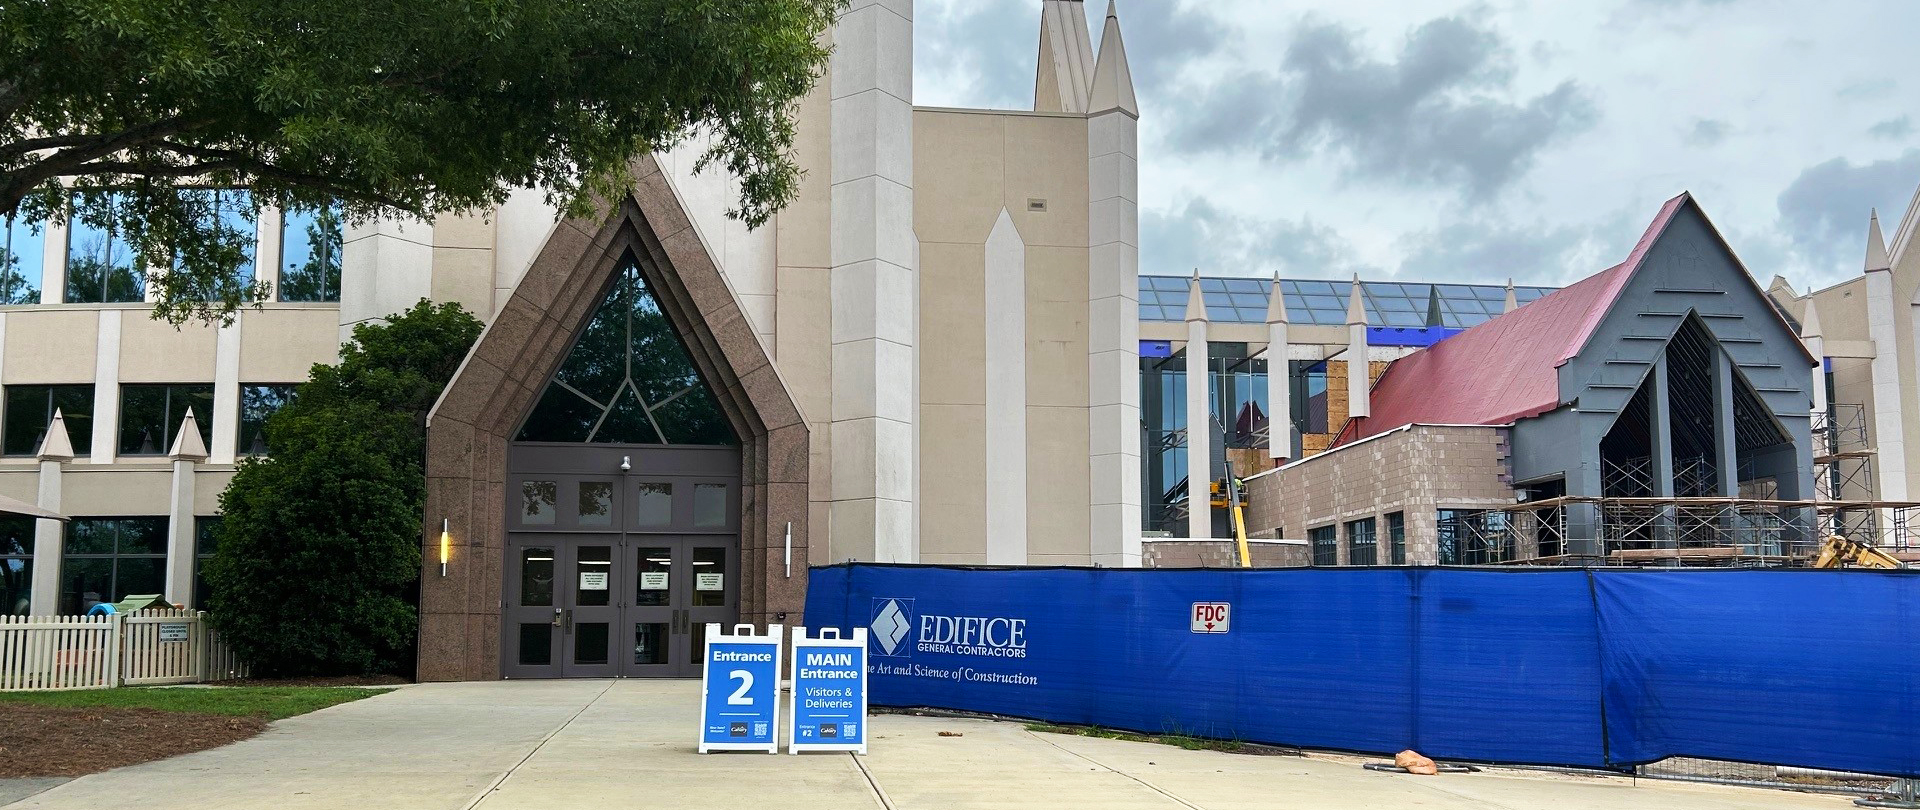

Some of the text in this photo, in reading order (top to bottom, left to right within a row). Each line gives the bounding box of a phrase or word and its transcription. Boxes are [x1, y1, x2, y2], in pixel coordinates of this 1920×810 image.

[1196, 606, 1225, 621] FDC
[918, 615, 1026, 648] EDIFICE
[713, 651, 771, 661] Entrance
[917, 643, 1026, 658] GENERAL CONTRACTORS
[807, 653, 852, 666] MAIN
[800, 668, 858, 678] Entrance
[877, 662, 891, 674] Art
[893, 664, 912, 676] and
[914, 664, 949, 678] Science
[951, 667, 964, 682] of
[964, 668, 1038, 685] Construction
[727, 669, 754, 705] 2
[806, 687, 852, 697] Visitors &
[805, 699, 853, 709] Deliveries
